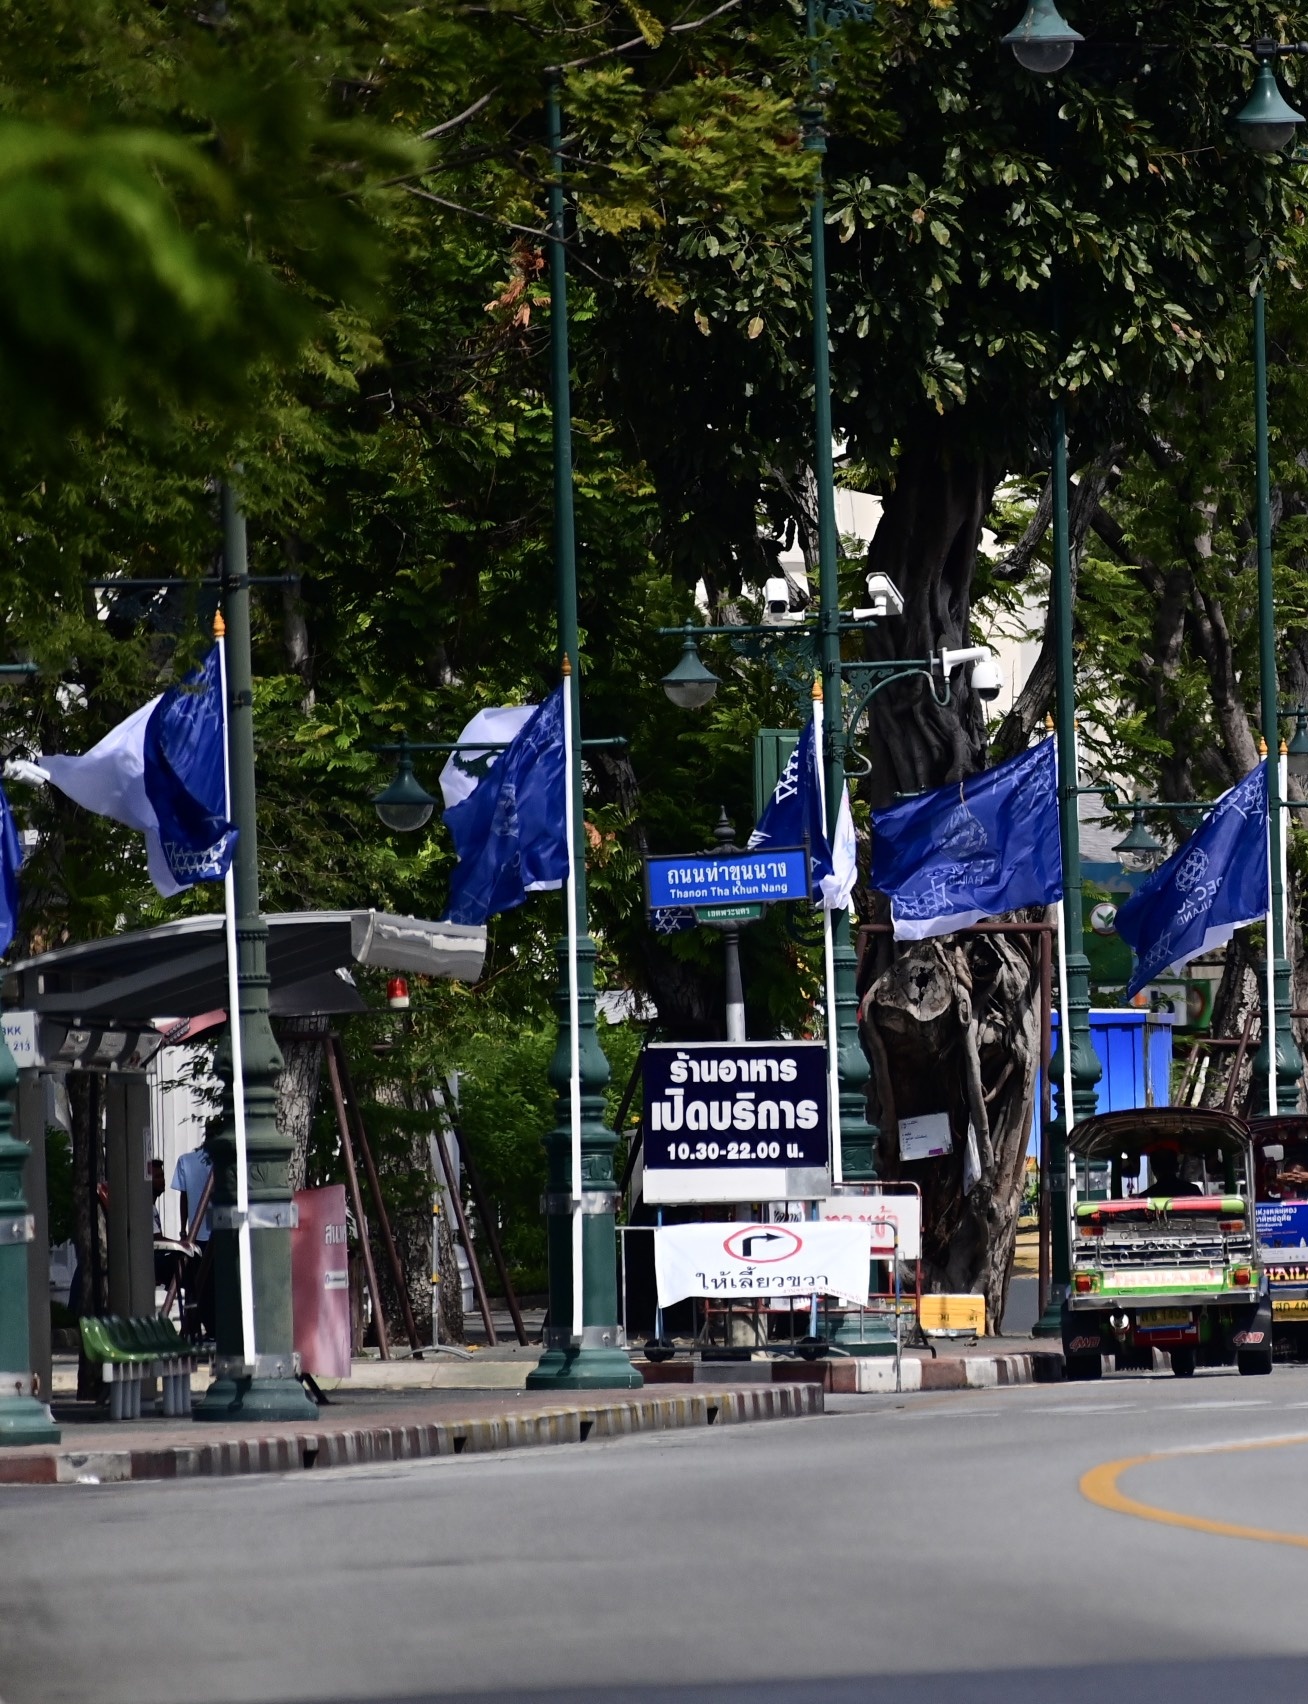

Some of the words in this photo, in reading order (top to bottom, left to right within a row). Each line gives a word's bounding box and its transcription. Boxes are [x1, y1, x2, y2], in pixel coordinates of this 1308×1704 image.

[667, 861, 787, 886] ถนนท่าขุนนาง
[669, 886, 708, 899] Thanon
[710, 886, 730, 897] Tha
[732, 884, 758, 896] Khun
[761, 882, 788, 894] Nang
[669, 1051, 798, 1083] ร้านอาหาร
[651, 1088, 819, 1131] เปิดบริการ
[667, 1141, 780, 1161] 10.30-22.00
[786, 1143, 804, 1159] น.
[695, 1266, 829, 1290] ให้เลี้ยวขวา
